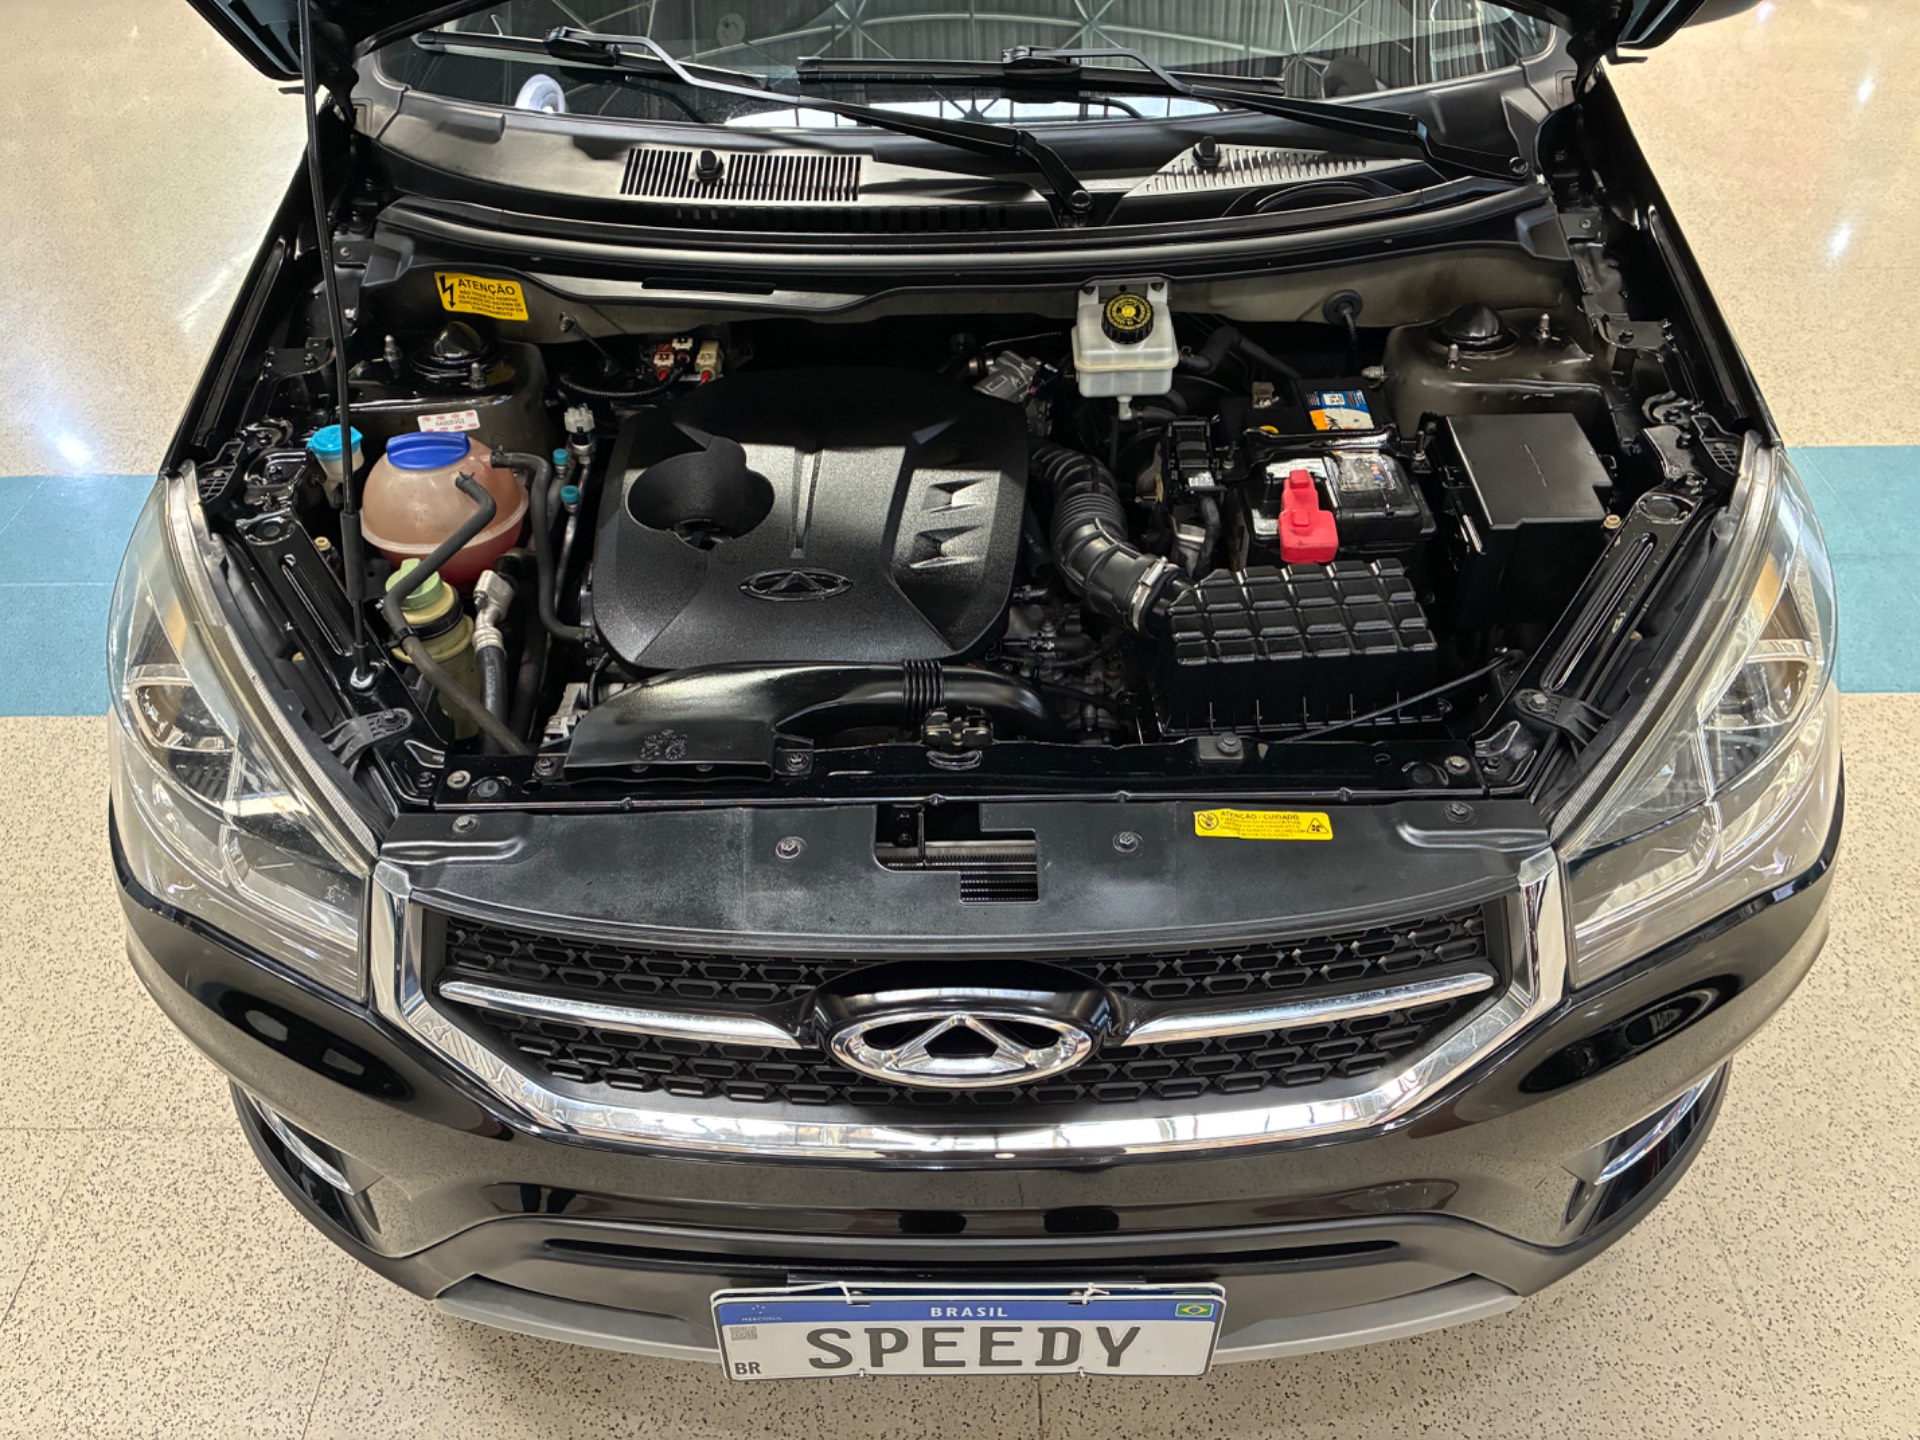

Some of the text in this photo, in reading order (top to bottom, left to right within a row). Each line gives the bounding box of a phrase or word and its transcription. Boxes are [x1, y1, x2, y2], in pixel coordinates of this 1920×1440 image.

[458, 278, 515, 295] ATENÇÃO
[1220, 810, 1256, 821] ATENÇÃO
[1263, 813, 1299, 821] CUIDADO
[930, 1306, 1008, 1317] BRASIL
[806, 1326, 1141, 1369] SPEEDY
[734, 1361, 762, 1375] BR
